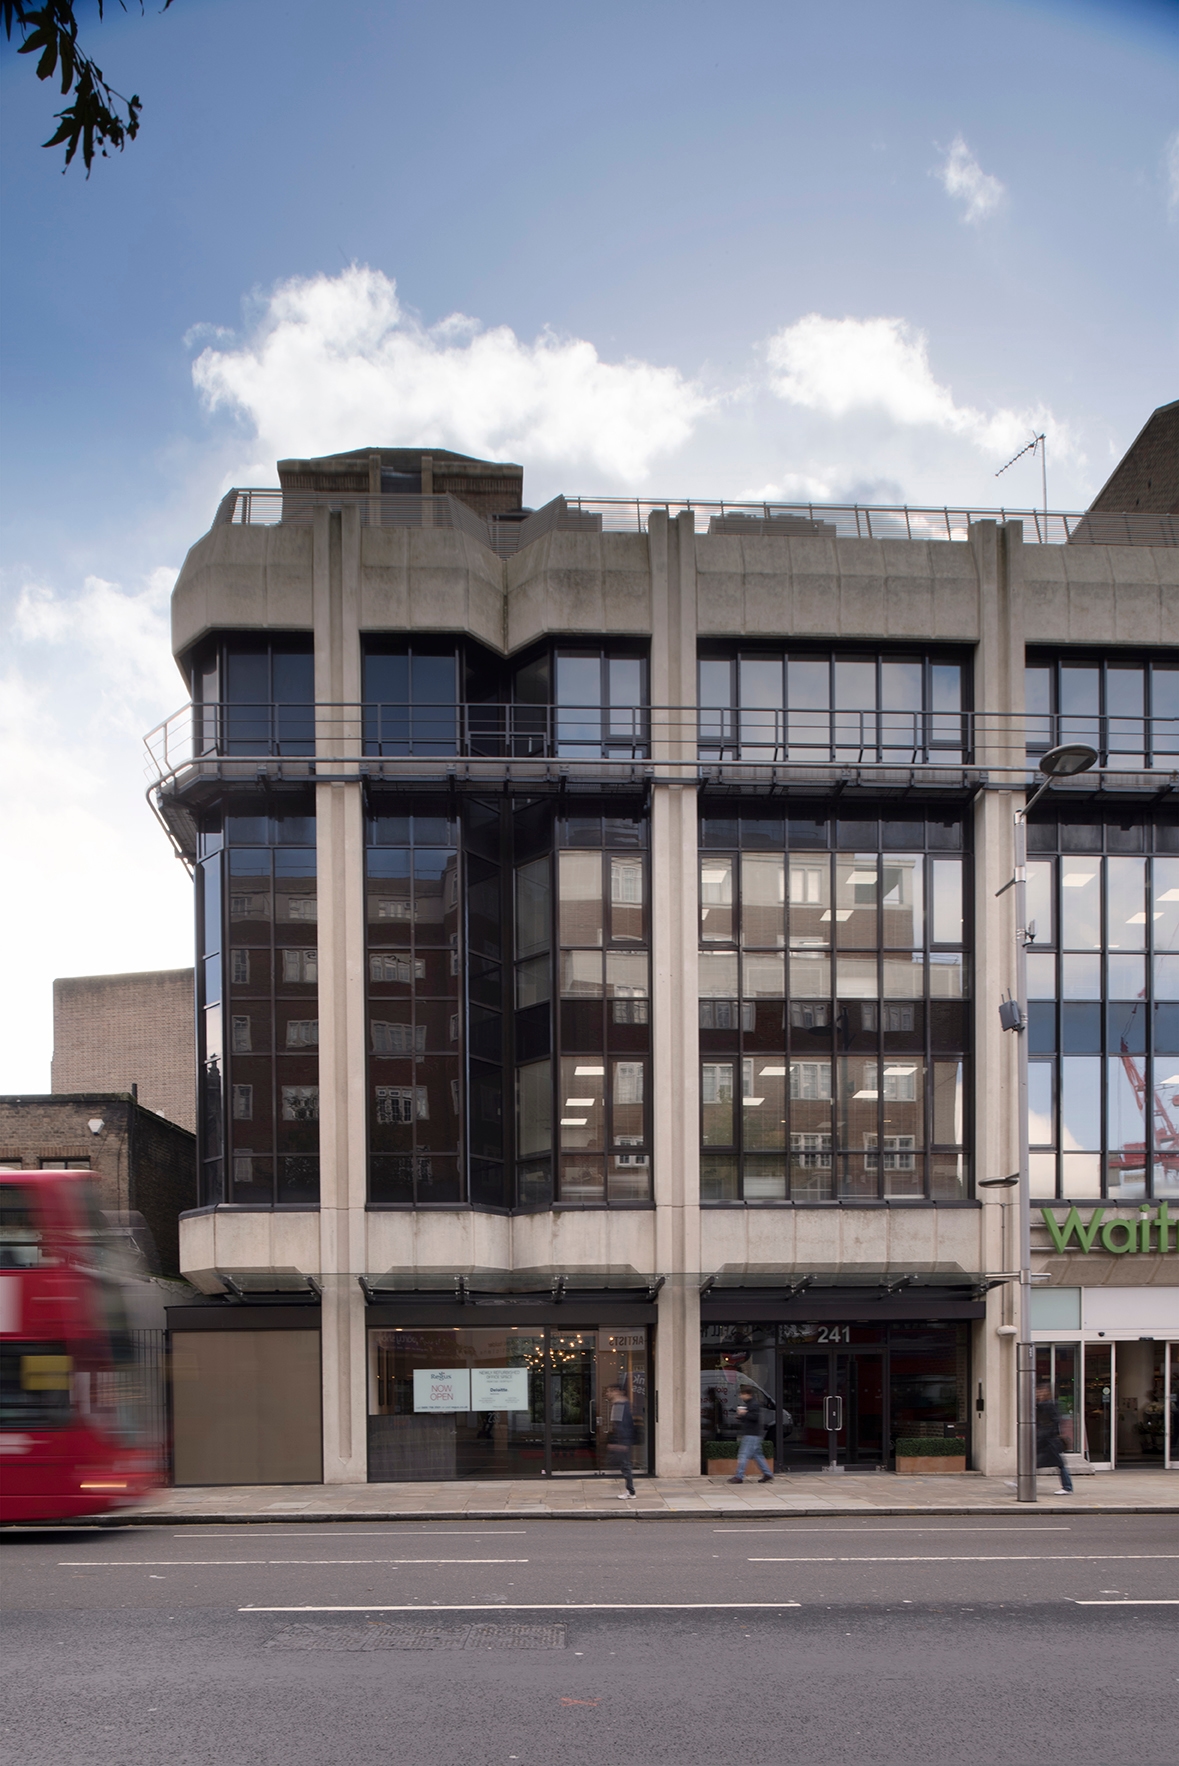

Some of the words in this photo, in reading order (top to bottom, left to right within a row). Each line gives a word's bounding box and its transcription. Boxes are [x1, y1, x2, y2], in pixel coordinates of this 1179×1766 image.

[1040, 1200, 1179, 1255] Wait
[817, 1326, 850, 1343] 241
[430, 1371, 452, 1381] Regus
